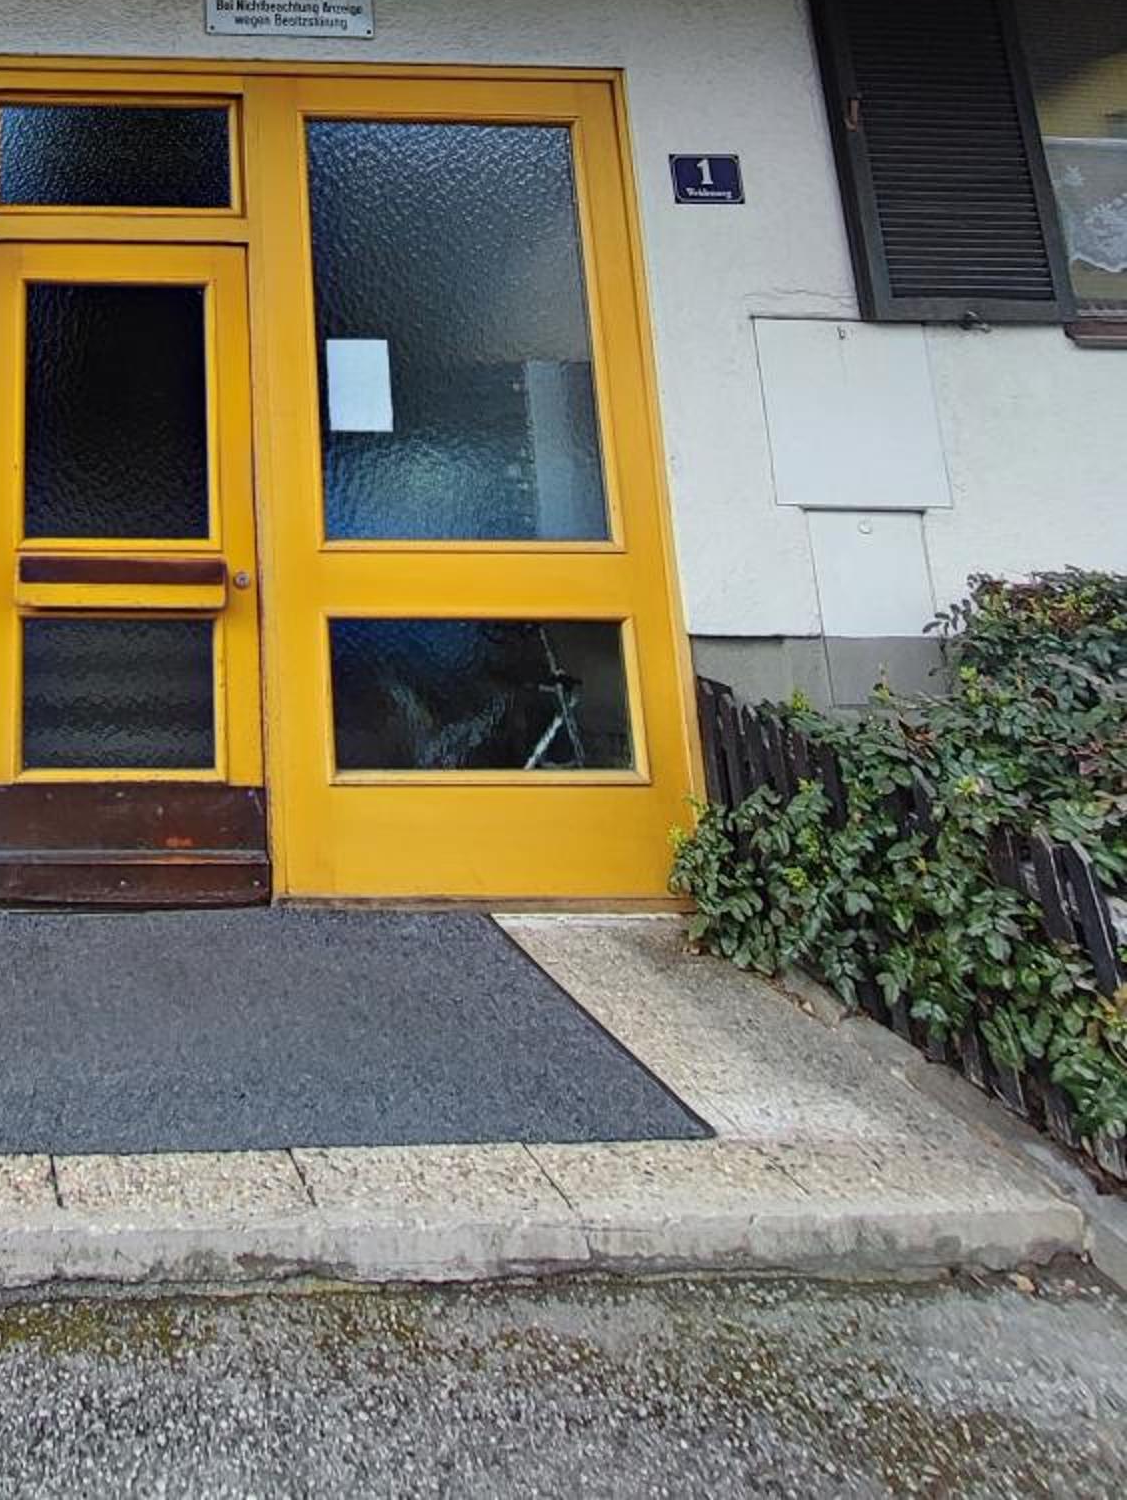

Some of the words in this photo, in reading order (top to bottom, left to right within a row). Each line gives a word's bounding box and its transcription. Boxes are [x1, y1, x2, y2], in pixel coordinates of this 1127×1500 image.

[217, 0, 233, 11] Bei
[236, 0, 320, 14] Nichtbeachtung
[697, 159, 713, 185] 1
